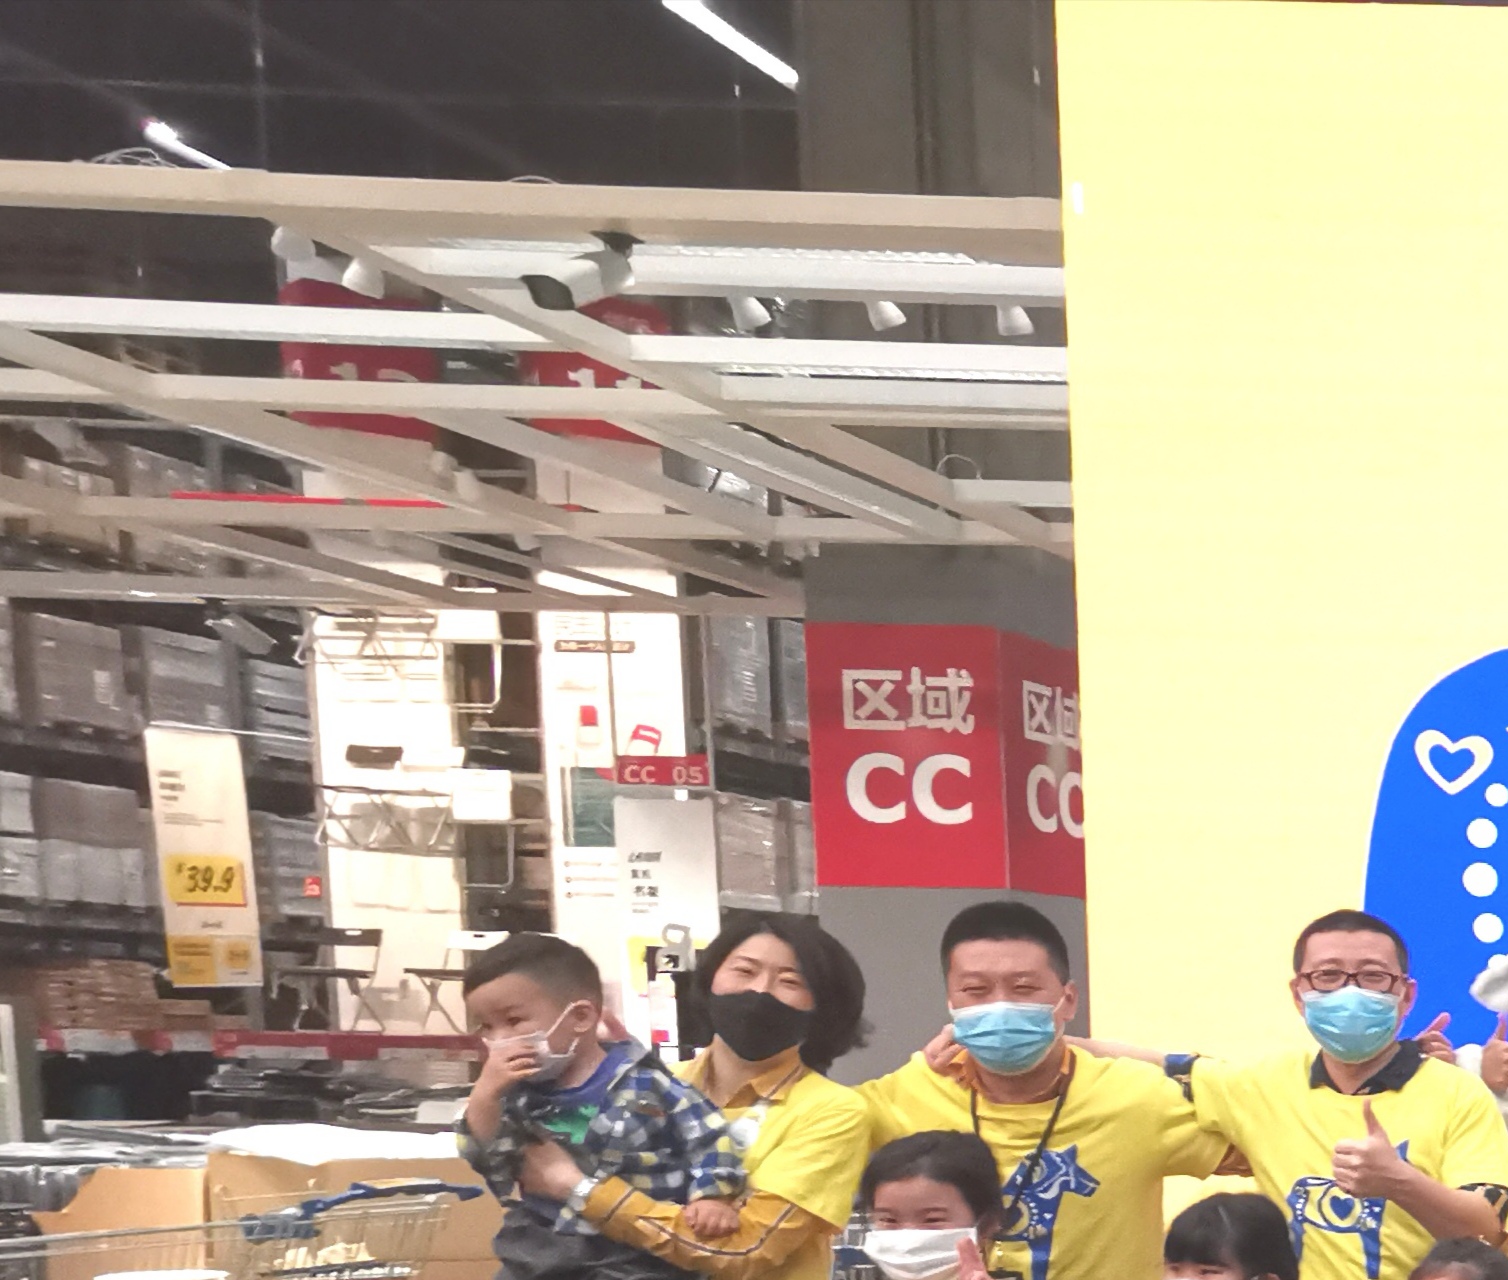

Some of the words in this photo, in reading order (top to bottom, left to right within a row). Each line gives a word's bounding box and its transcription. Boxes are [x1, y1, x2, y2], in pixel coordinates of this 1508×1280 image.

[842, 666, 975, 735] 区域
[623, 765, 656, 784] CC
[672, 766, 704, 785] 05
[846, 752, 974, 825] CC
